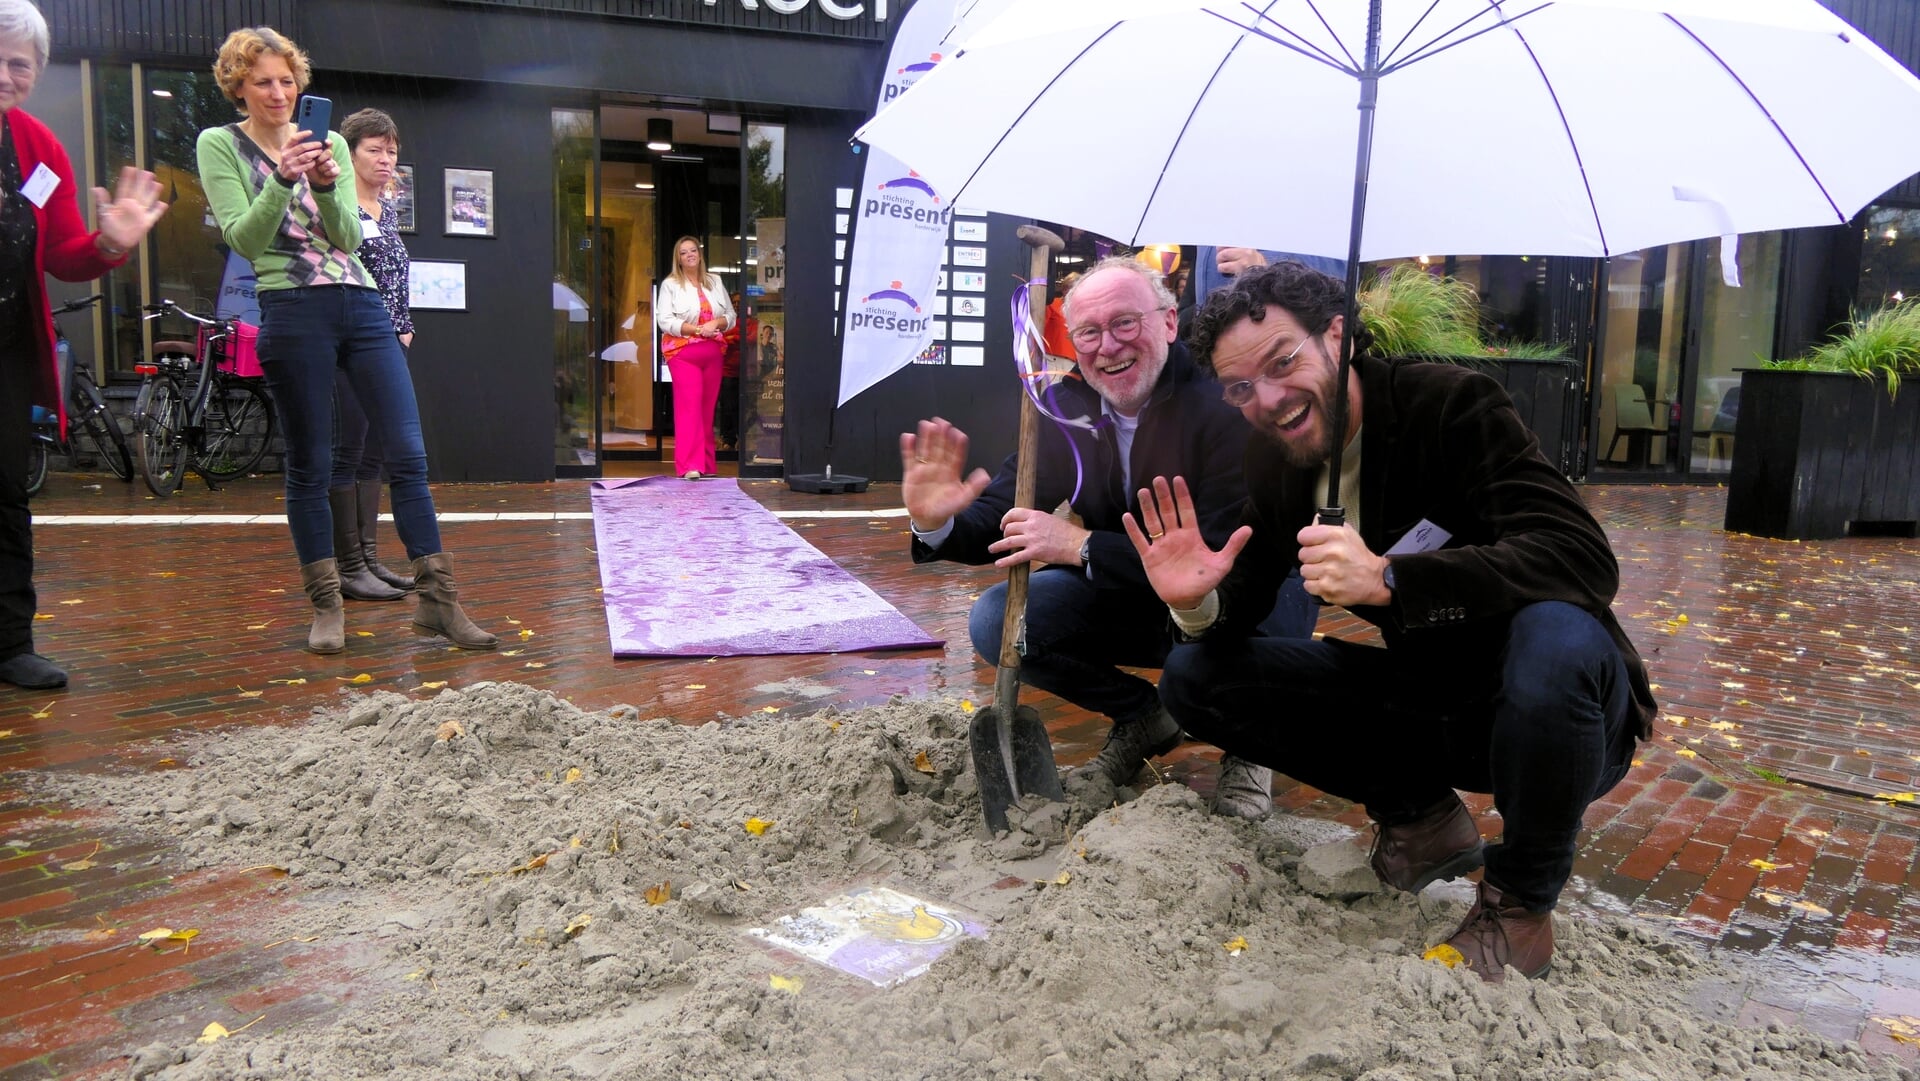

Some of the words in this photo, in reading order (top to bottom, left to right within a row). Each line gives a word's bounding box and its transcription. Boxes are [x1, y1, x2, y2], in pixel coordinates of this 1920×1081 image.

[882, 194, 915, 206] stichting
[864, 199, 948, 225] present
[224, 286, 256, 299] pres
[865, 307, 897, 317] stichting
[850, 312, 929, 332] present
